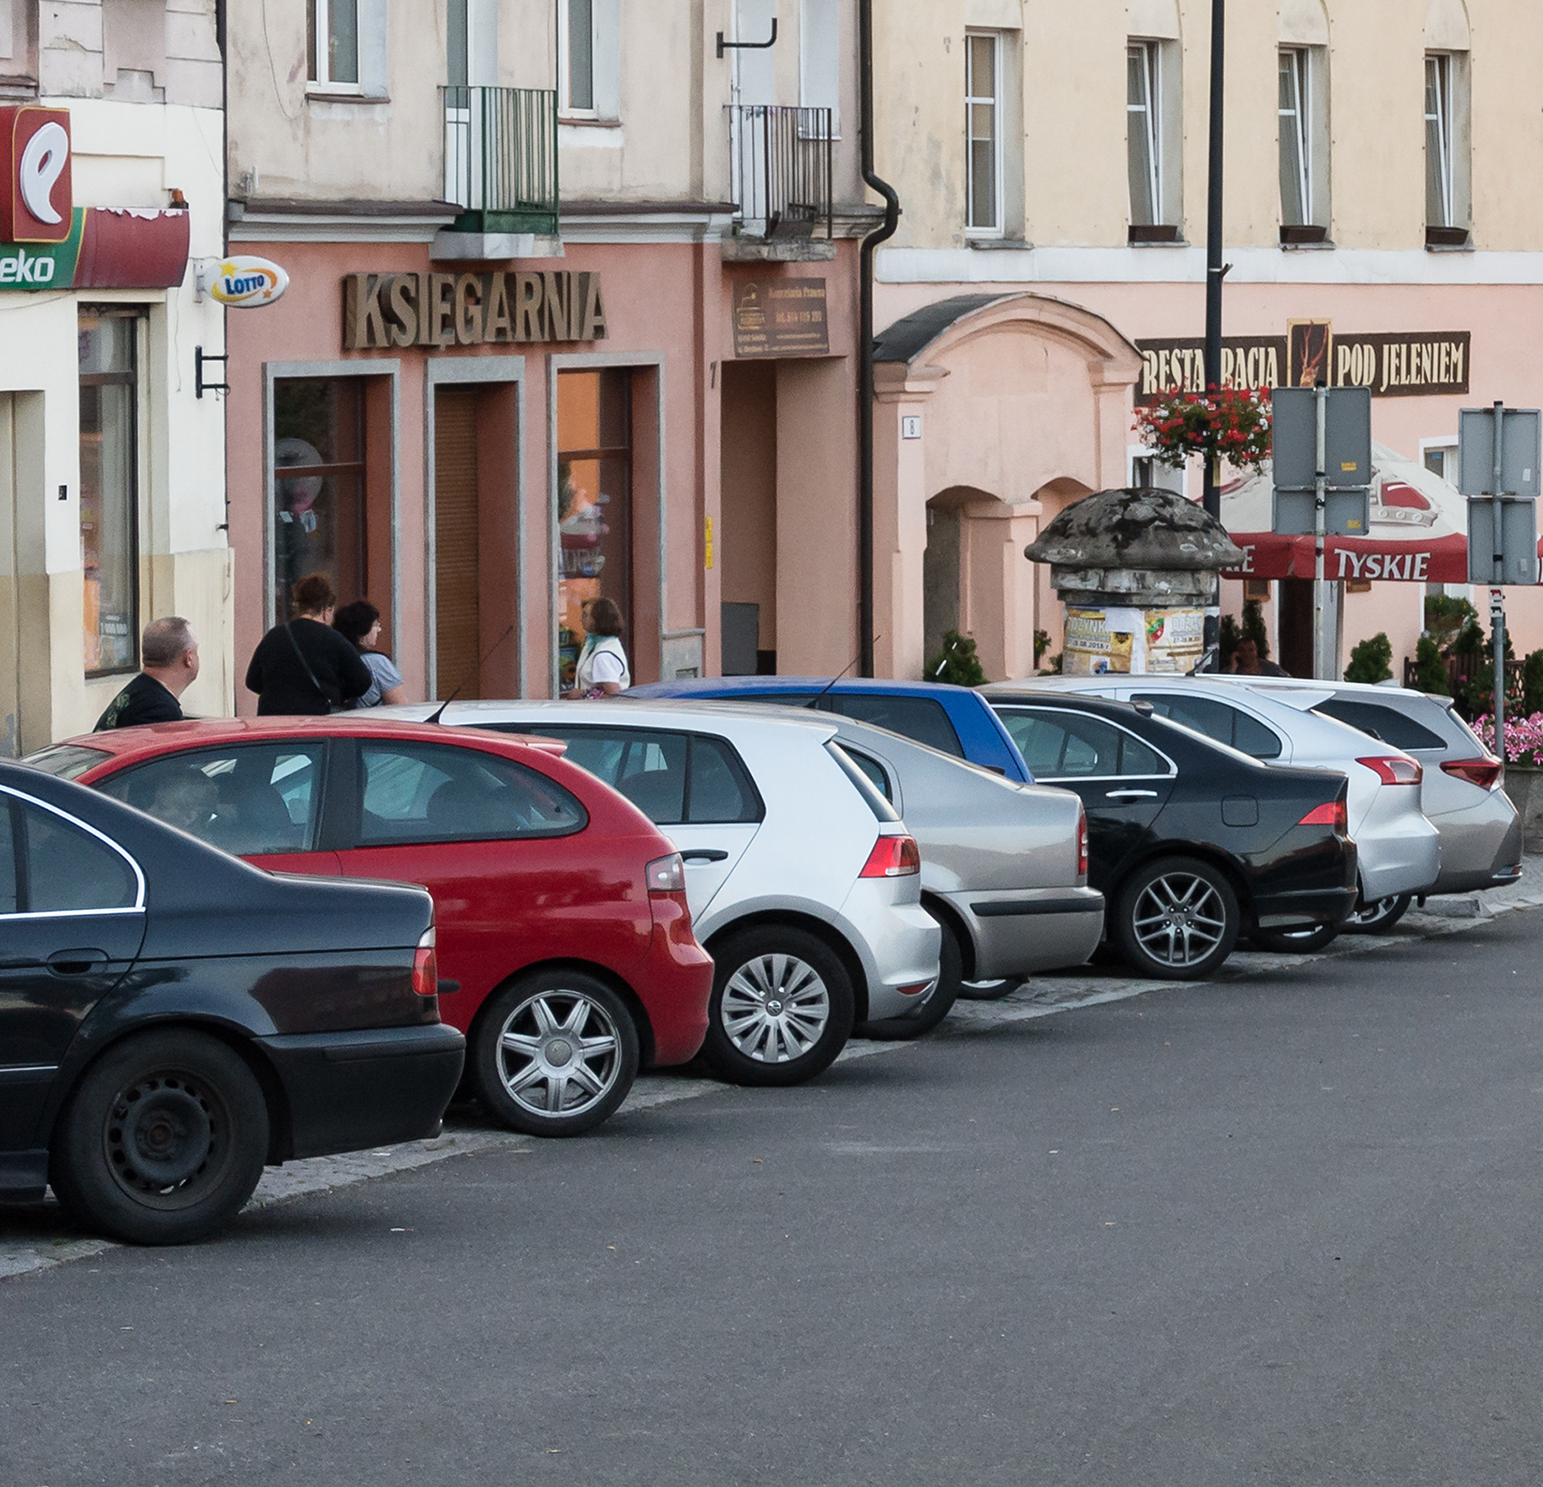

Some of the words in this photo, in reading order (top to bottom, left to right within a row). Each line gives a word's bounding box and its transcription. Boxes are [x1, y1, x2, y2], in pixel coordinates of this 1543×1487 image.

[224, 274, 266, 296] LOTTO
[345, 271, 610, 351] KSIĘGARNIA
[1336, 343, 1377, 387] POD
[1379, 341, 1465, 393] JELENIEM
[1334, 548, 1431, 581] TYSKIE
